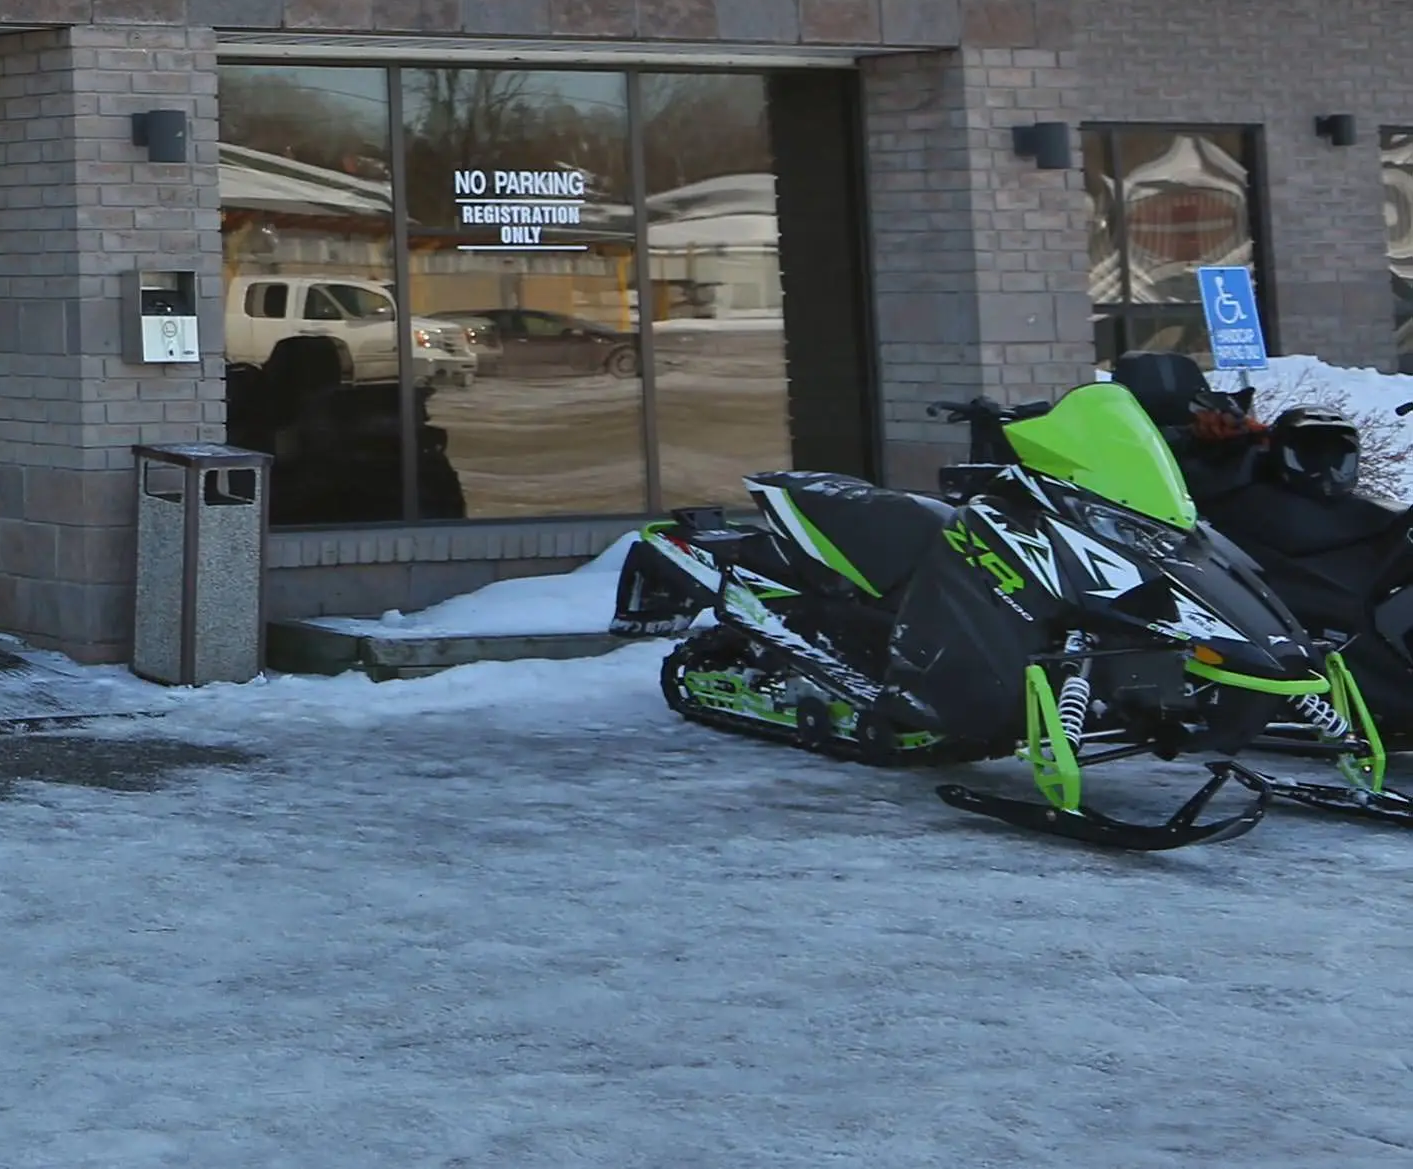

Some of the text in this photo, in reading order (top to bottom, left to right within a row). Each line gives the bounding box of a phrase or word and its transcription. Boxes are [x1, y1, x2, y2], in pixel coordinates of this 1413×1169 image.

[455, 171, 584, 195] NO PARKING
[463, 206, 580, 224] REGISTRATION
[501, 226, 542, 244] ONLY
